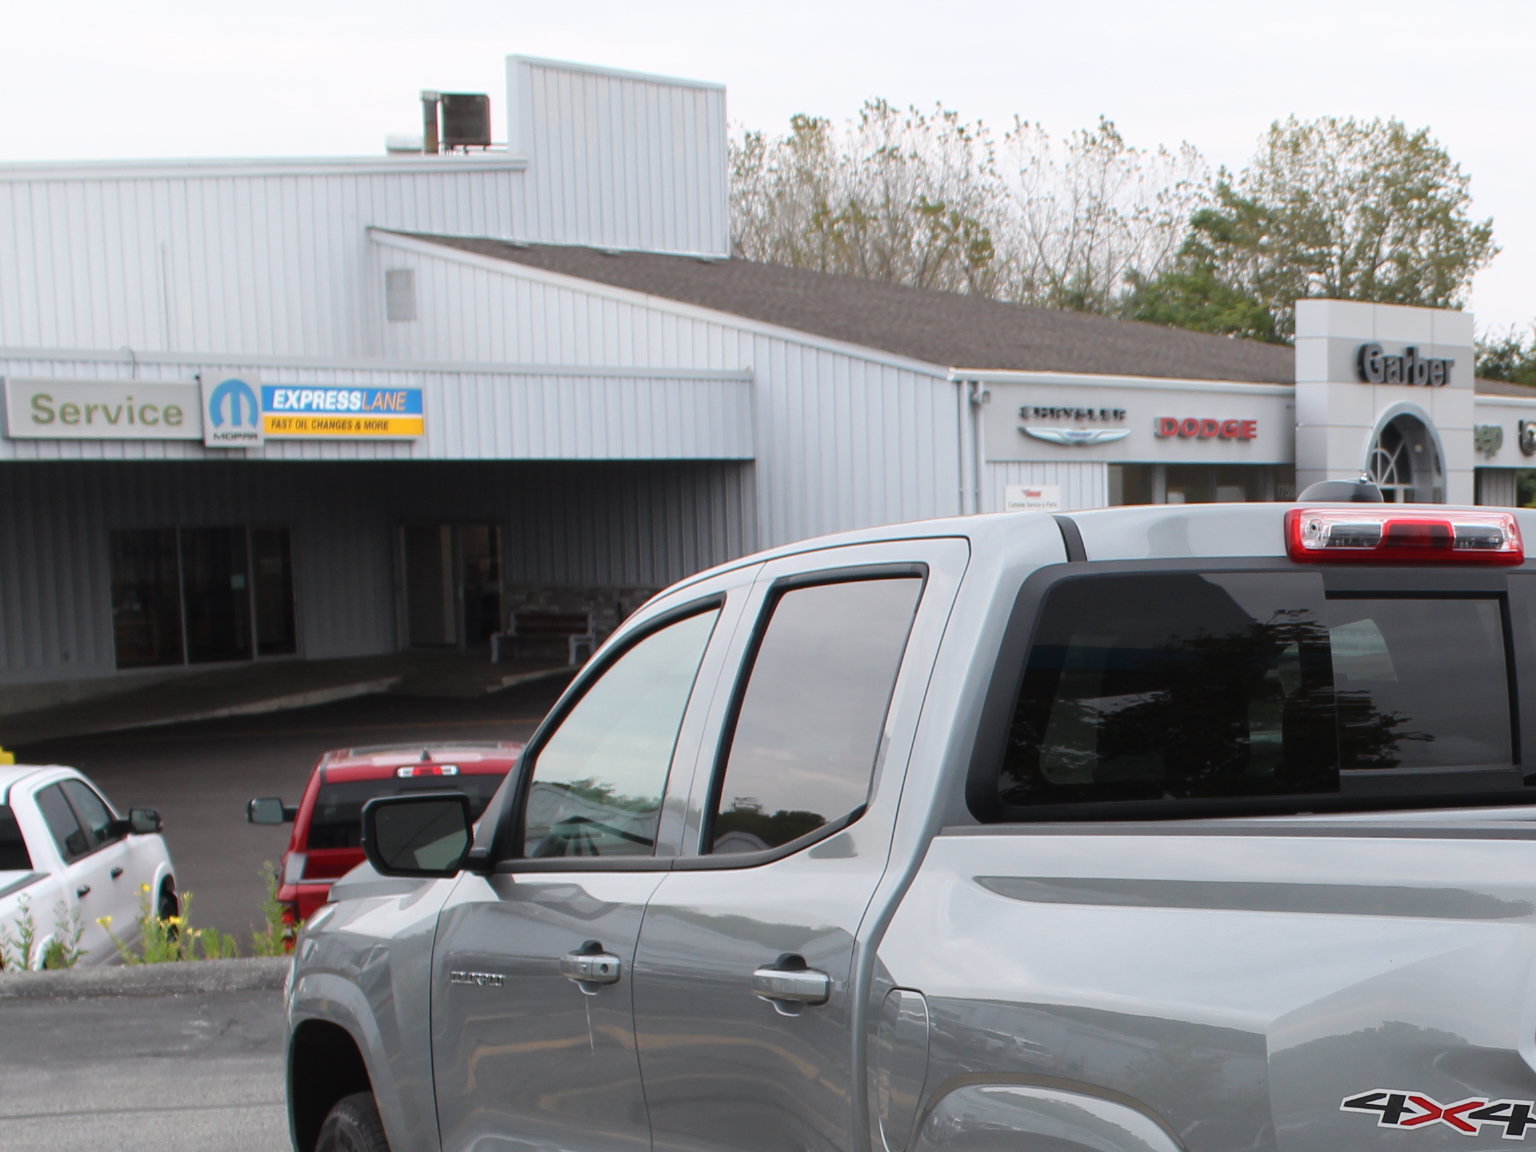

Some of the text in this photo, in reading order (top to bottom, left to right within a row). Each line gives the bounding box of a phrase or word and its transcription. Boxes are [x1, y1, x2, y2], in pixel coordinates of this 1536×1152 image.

[1357, 343, 1454, 387] Garber
[30, 393, 184, 426] Service
[213, 432, 258, 441] MOPAR
[271, 418, 292, 430] FAST
[295, 419, 309, 430] OIL
[311, 419, 352, 431] CHANGES
[363, 420, 389, 432] MORE
[1157, 416, 1258, 440] DODGE
